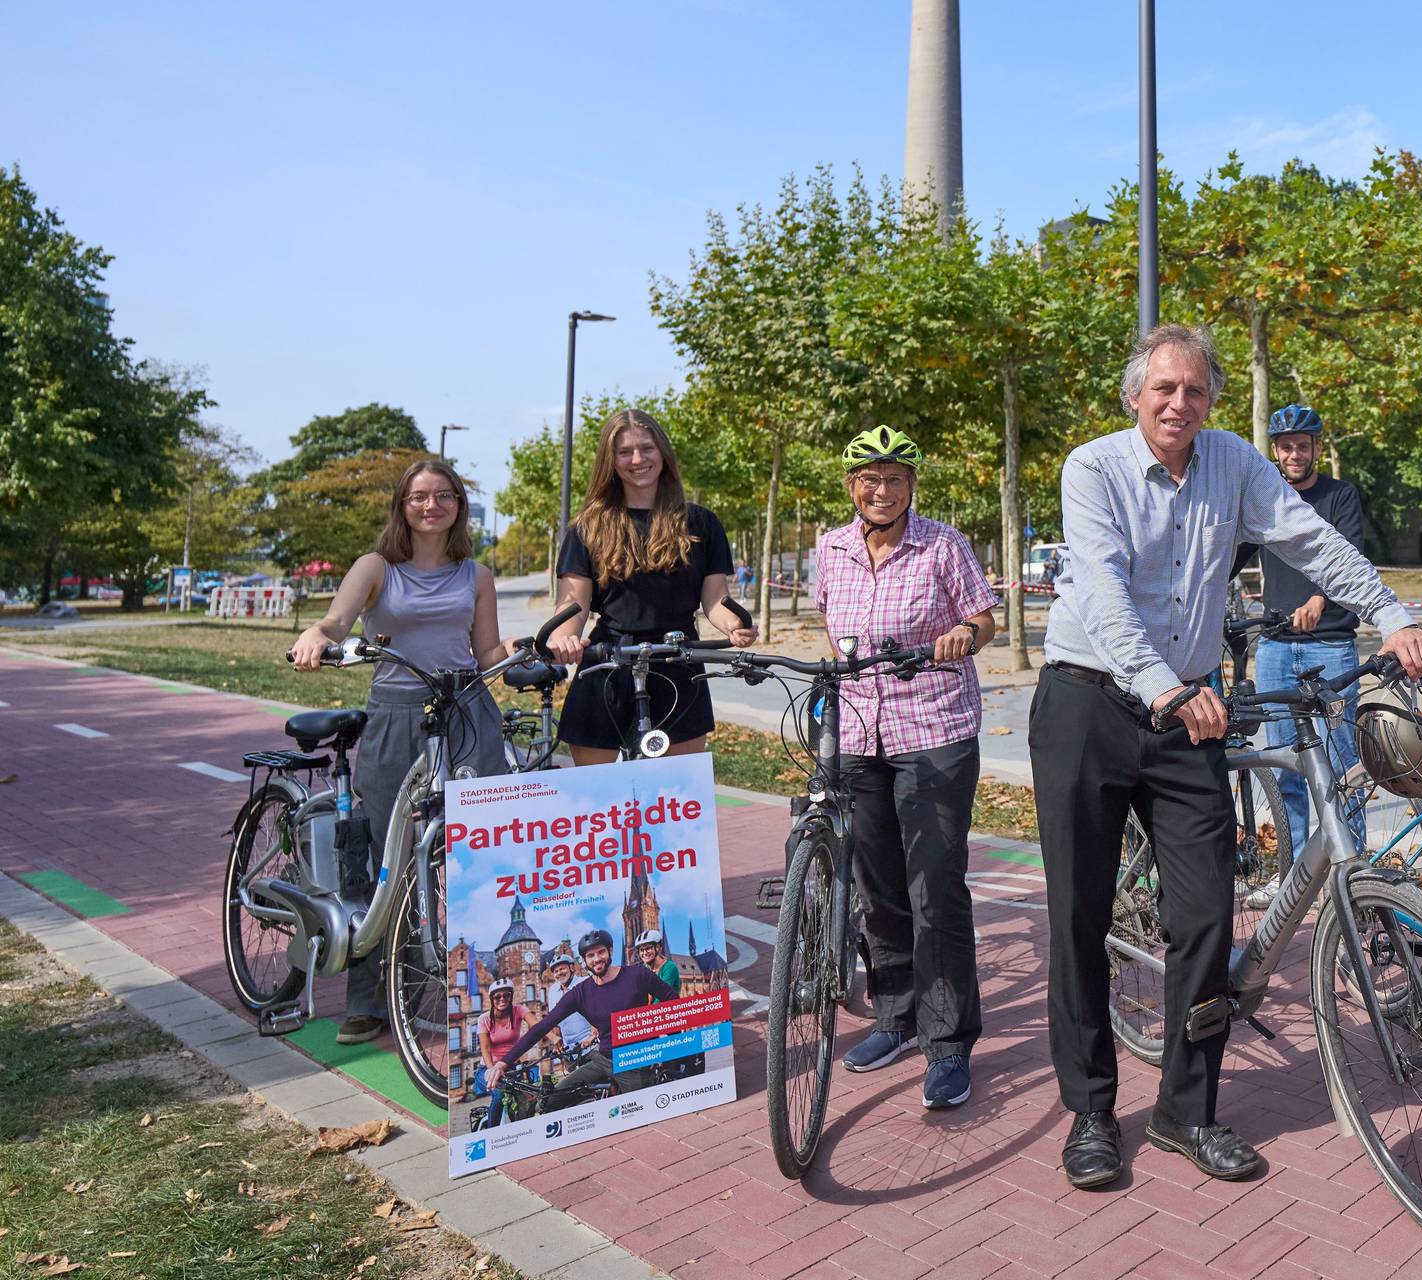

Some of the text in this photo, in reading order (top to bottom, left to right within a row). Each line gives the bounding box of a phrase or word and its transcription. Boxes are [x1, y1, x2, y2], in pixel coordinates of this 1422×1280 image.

[460, 785, 520, 798] STADTRADELN
[521, 782, 542, 791] 2025
[460, 789, 558, 806] Düsseldorf und Chemnitz
[446, 797, 701, 853] Partnerstädte
[536, 828, 652, 868] radeln
[496, 848, 697, 898] zusammen
[533, 891, 576, 904] Düsseldorf
[533, 895, 605, 912] Nähe trifft Freiheit
[1248, 861, 1313, 970] SPECIALIZED
[617, 994, 722, 1023] Jetzt kostenlos anmelden und
[617, 1023, 634, 1031] vom
[641, 1018, 652, 1026] bis
[653, 1016, 664, 1024] 21.
[665, 1007, 704, 1020] September
[704, 1002, 723, 1012] 2025
[617, 1019, 687, 1040] Kilometer sammeln
[618, 1035, 696, 1058] www.stadtradeln.de/
[618, 1051, 662, 1067] duesseldorf
[671, 1083, 724, 1102] STADTRADELN
[621, 1101, 637, 1110] KLIMA
[567, 1111, 595, 1123] CHEMNITZ
